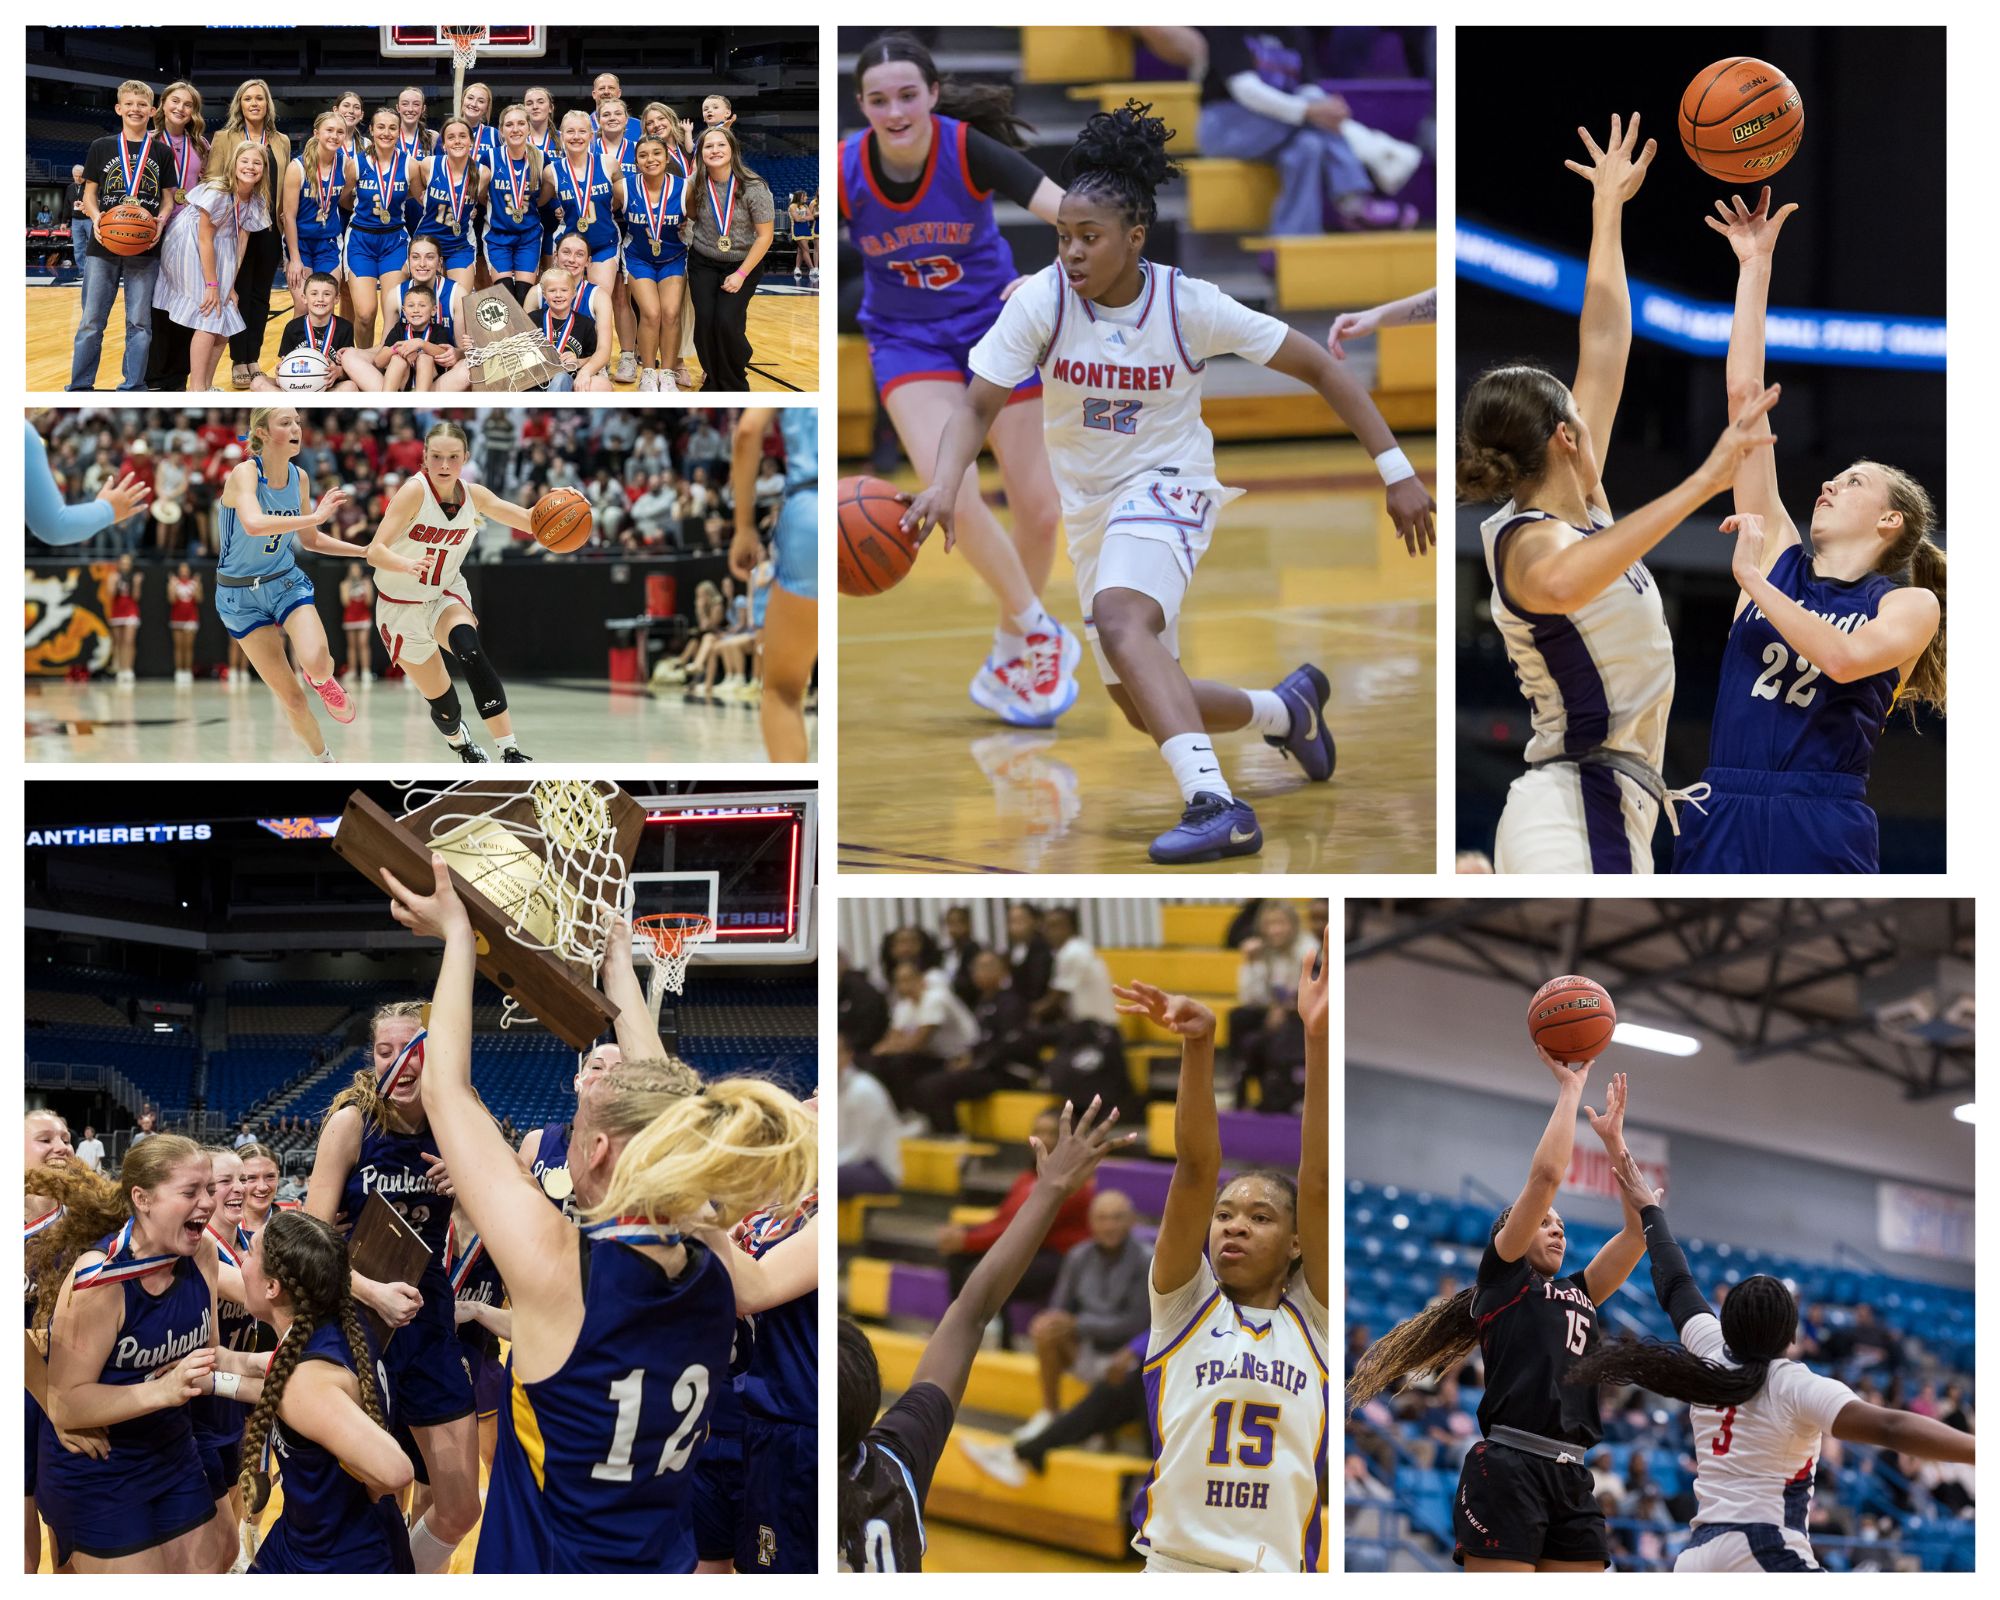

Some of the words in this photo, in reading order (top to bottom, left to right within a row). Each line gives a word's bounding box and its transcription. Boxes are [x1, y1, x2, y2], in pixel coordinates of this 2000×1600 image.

[1731, 113, 1766, 144] PRO
[887, 254, 964, 291] 13
[1053, 357, 1176, 392] MONTEREY
[1082, 397, 1143, 435] 22
[1750, 641, 1822, 708] 22
[26, 824, 212, 846] ANTHERETTES
[1579, 996, 1600, 1009] PRO
[1565, 1309, 1591, 1356] 15
[591, 1363, 710, 1482] 12
[1205, 1397, 1283, 1470] 15
[1711, 1405, 1738, 1456] 3
[1205, 1479, 1270, 1510] HIGH
